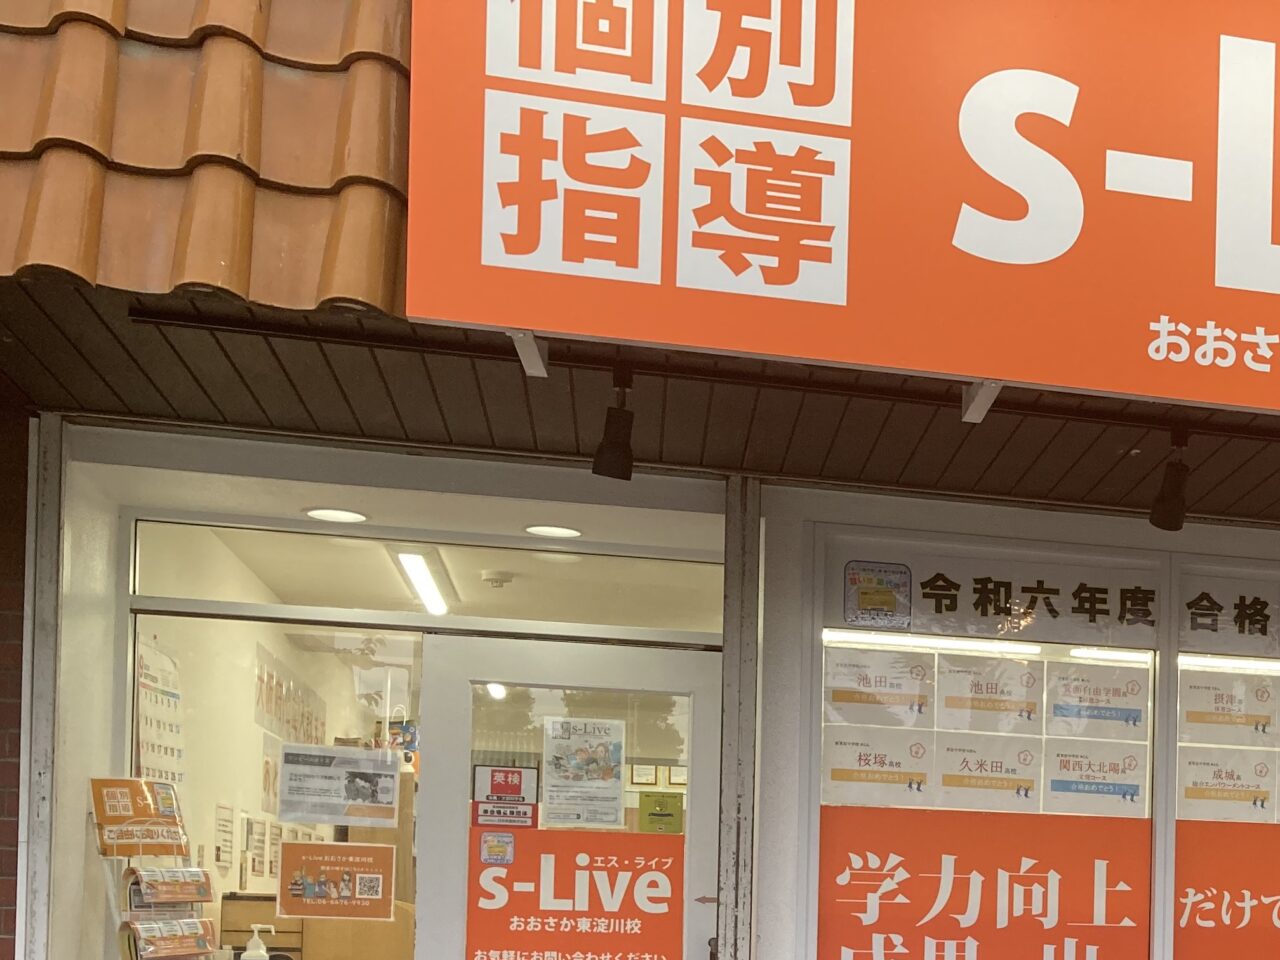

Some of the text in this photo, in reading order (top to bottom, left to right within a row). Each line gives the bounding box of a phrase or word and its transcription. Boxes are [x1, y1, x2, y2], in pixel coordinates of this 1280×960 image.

[497, 107, 836, 287] 指導
[920, 572, 1156, 628] 令和六年度
[492, 771, 521, 785] 英検
[477, 853, 673, 914] s-Live
[593, 856, 674, 870] エス・ライブ
[835, 851, 1137, 930] 学力向上
[509, 916, 642, 934] おおさか東淀川校
